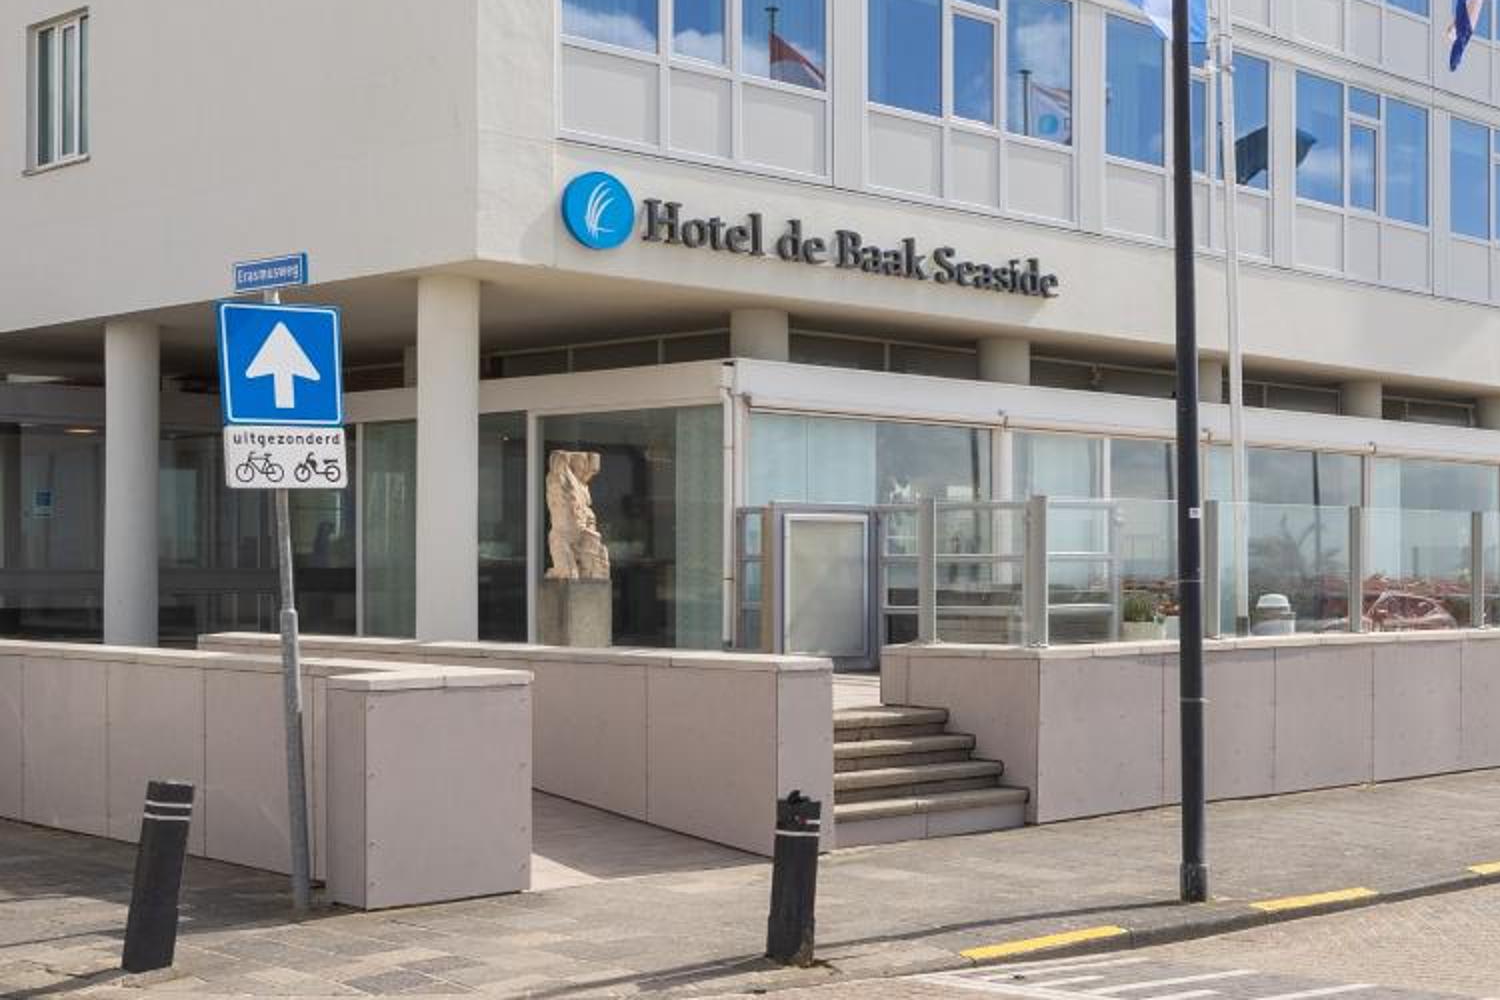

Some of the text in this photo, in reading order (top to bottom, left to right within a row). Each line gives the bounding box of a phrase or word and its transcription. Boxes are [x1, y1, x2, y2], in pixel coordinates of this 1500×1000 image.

[641, 197, 1059, 298] Hotel de Baak Seaside
[233, 431, 340, 448] uitgezonderd
